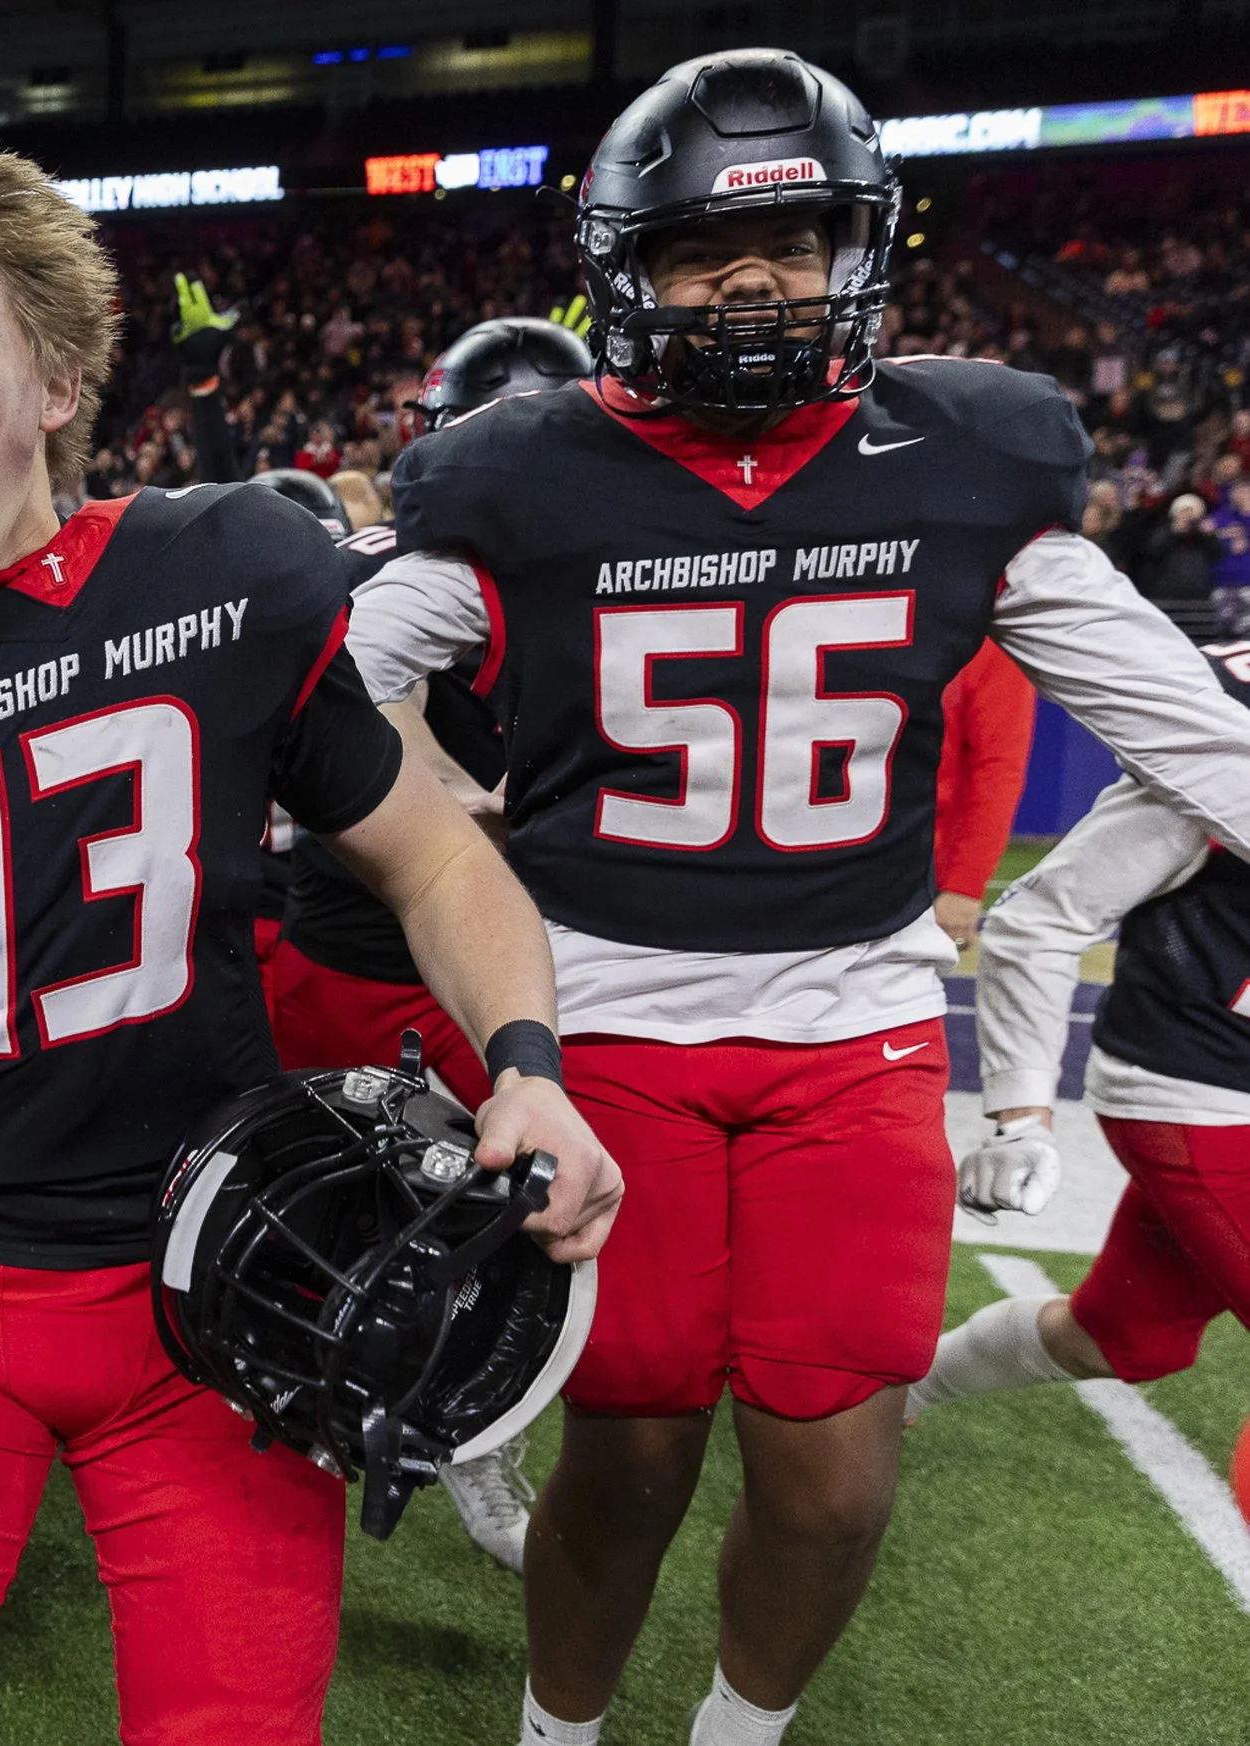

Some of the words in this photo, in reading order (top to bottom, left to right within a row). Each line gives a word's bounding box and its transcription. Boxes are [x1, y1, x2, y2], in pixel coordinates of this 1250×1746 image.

[727, 161, 814, 188] Riddell
[595, 548, 777, 595] ARCHBISHOP
[793, 538, 920, 582] MURPHY
[104, 598, 249, 680] MURPHY
[593, 588, 916, 852] 56
[463, 1279, 482, 1312] TRUE
